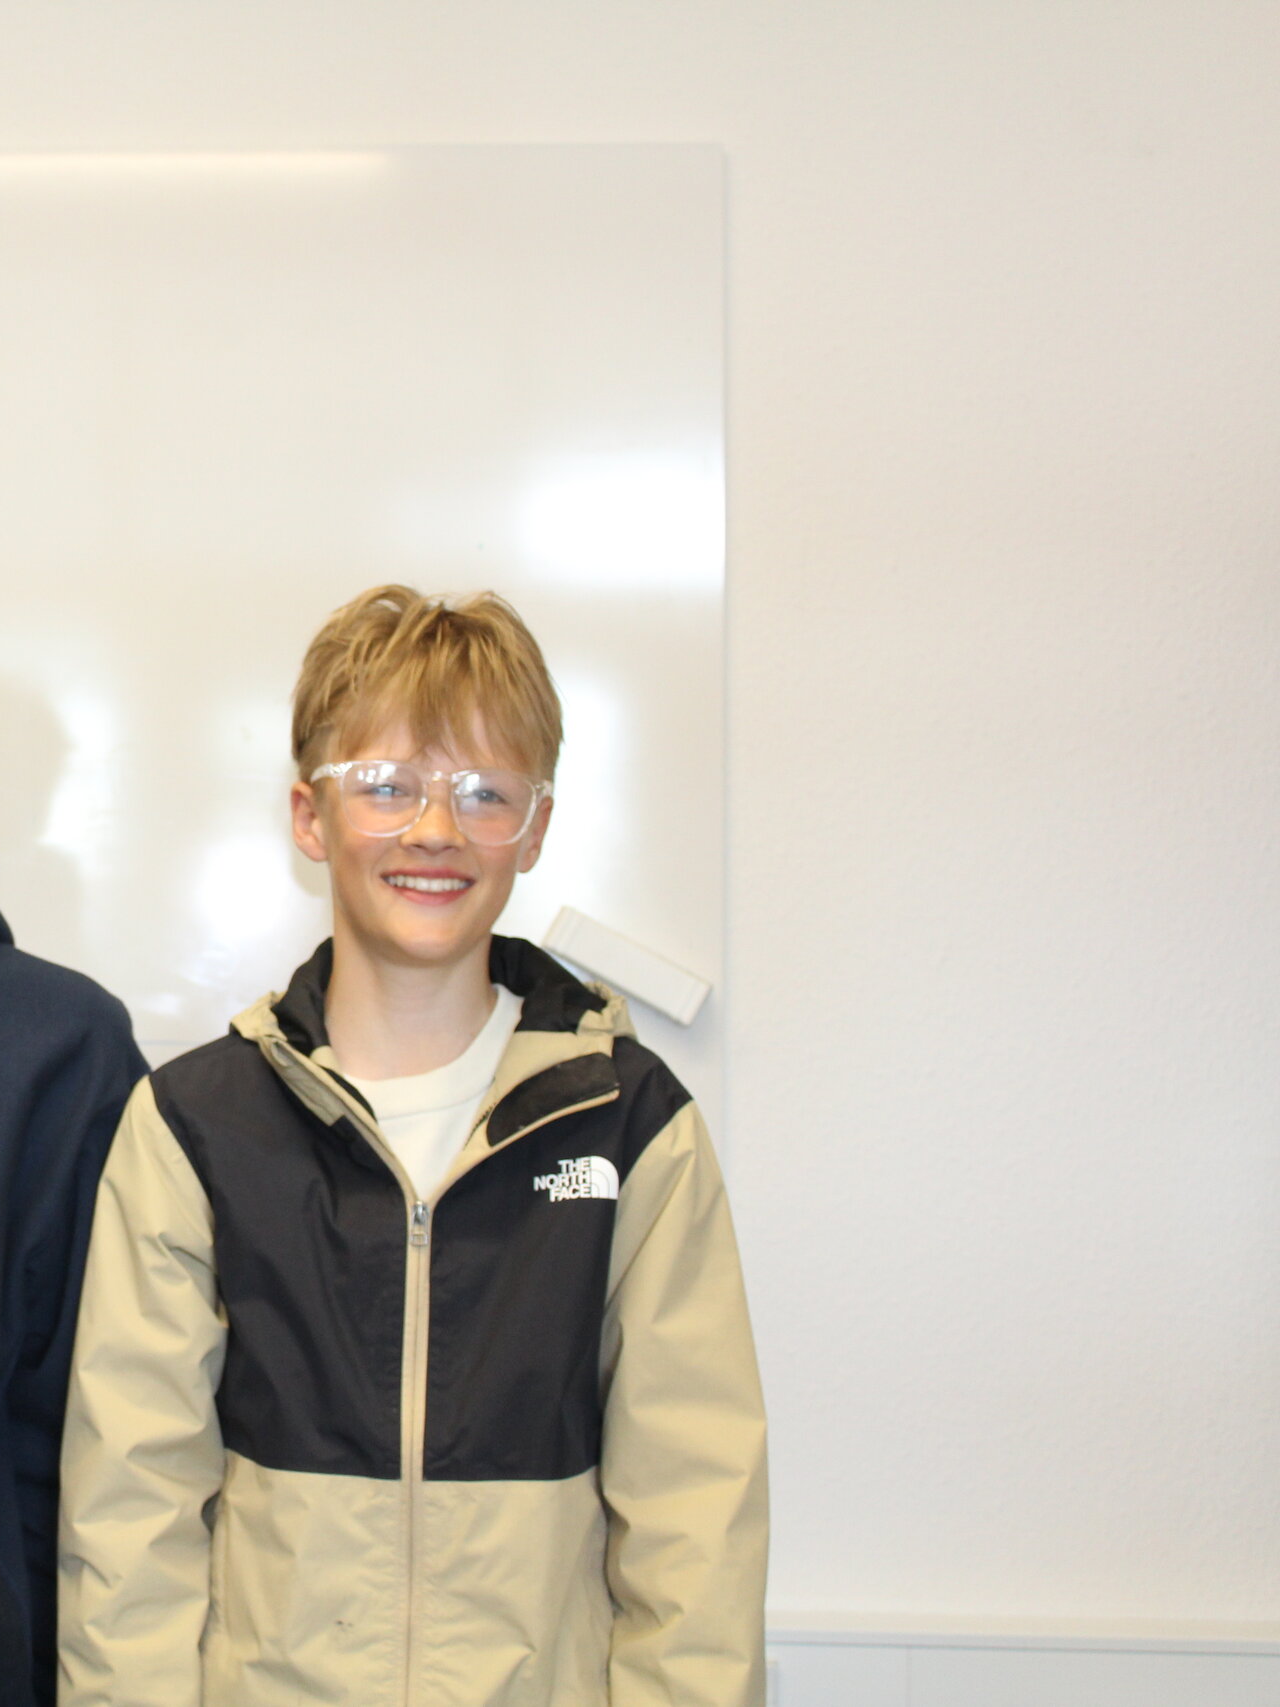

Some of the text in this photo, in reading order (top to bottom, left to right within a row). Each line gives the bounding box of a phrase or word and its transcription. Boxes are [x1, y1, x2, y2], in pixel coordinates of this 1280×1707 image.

[557, 1157, 591, 1174] THE
[533, 1170, 591, 1191] NORTH
[549, 1184, 591, 1202] FACE
